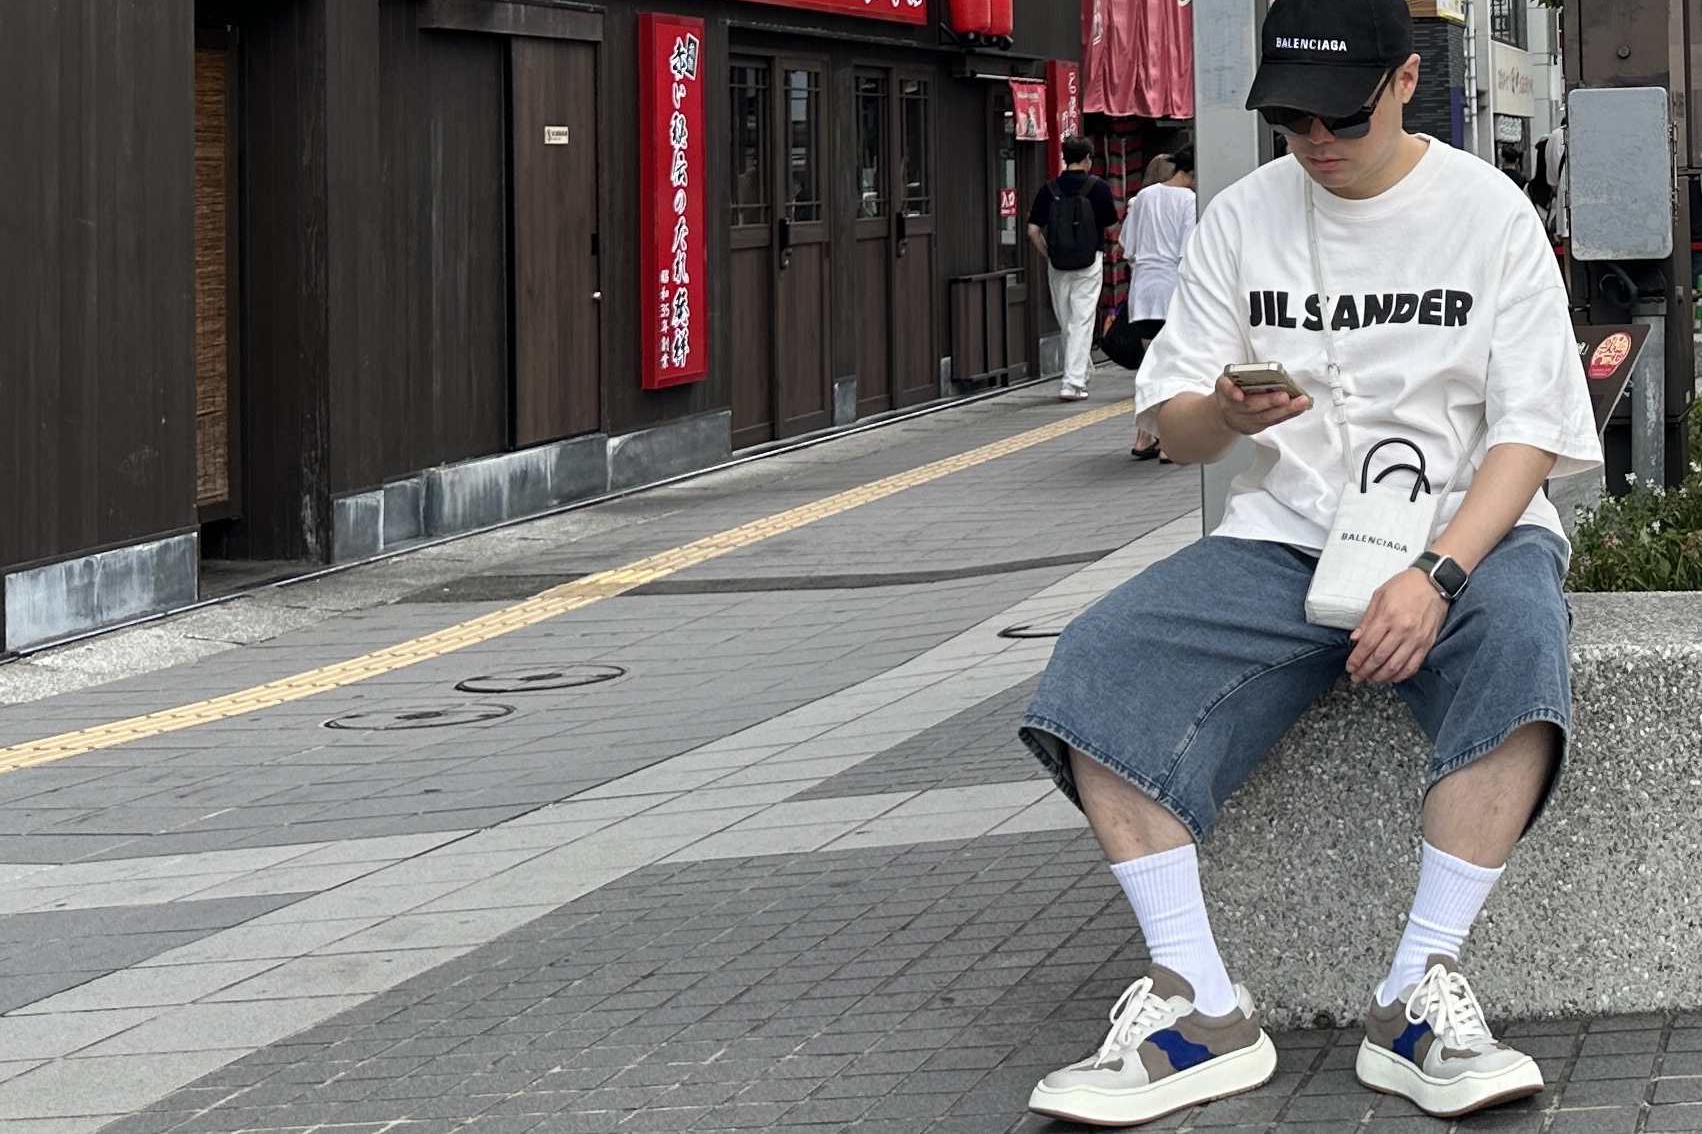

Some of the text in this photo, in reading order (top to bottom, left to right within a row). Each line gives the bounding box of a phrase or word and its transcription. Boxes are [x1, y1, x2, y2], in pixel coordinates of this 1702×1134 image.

[1275, 36, 1348, 52] BALENCIAGA
[1249, 288, 1473, 332] JIL SANDER
[1341, 532, 1408, 553] BALENCIAGA
